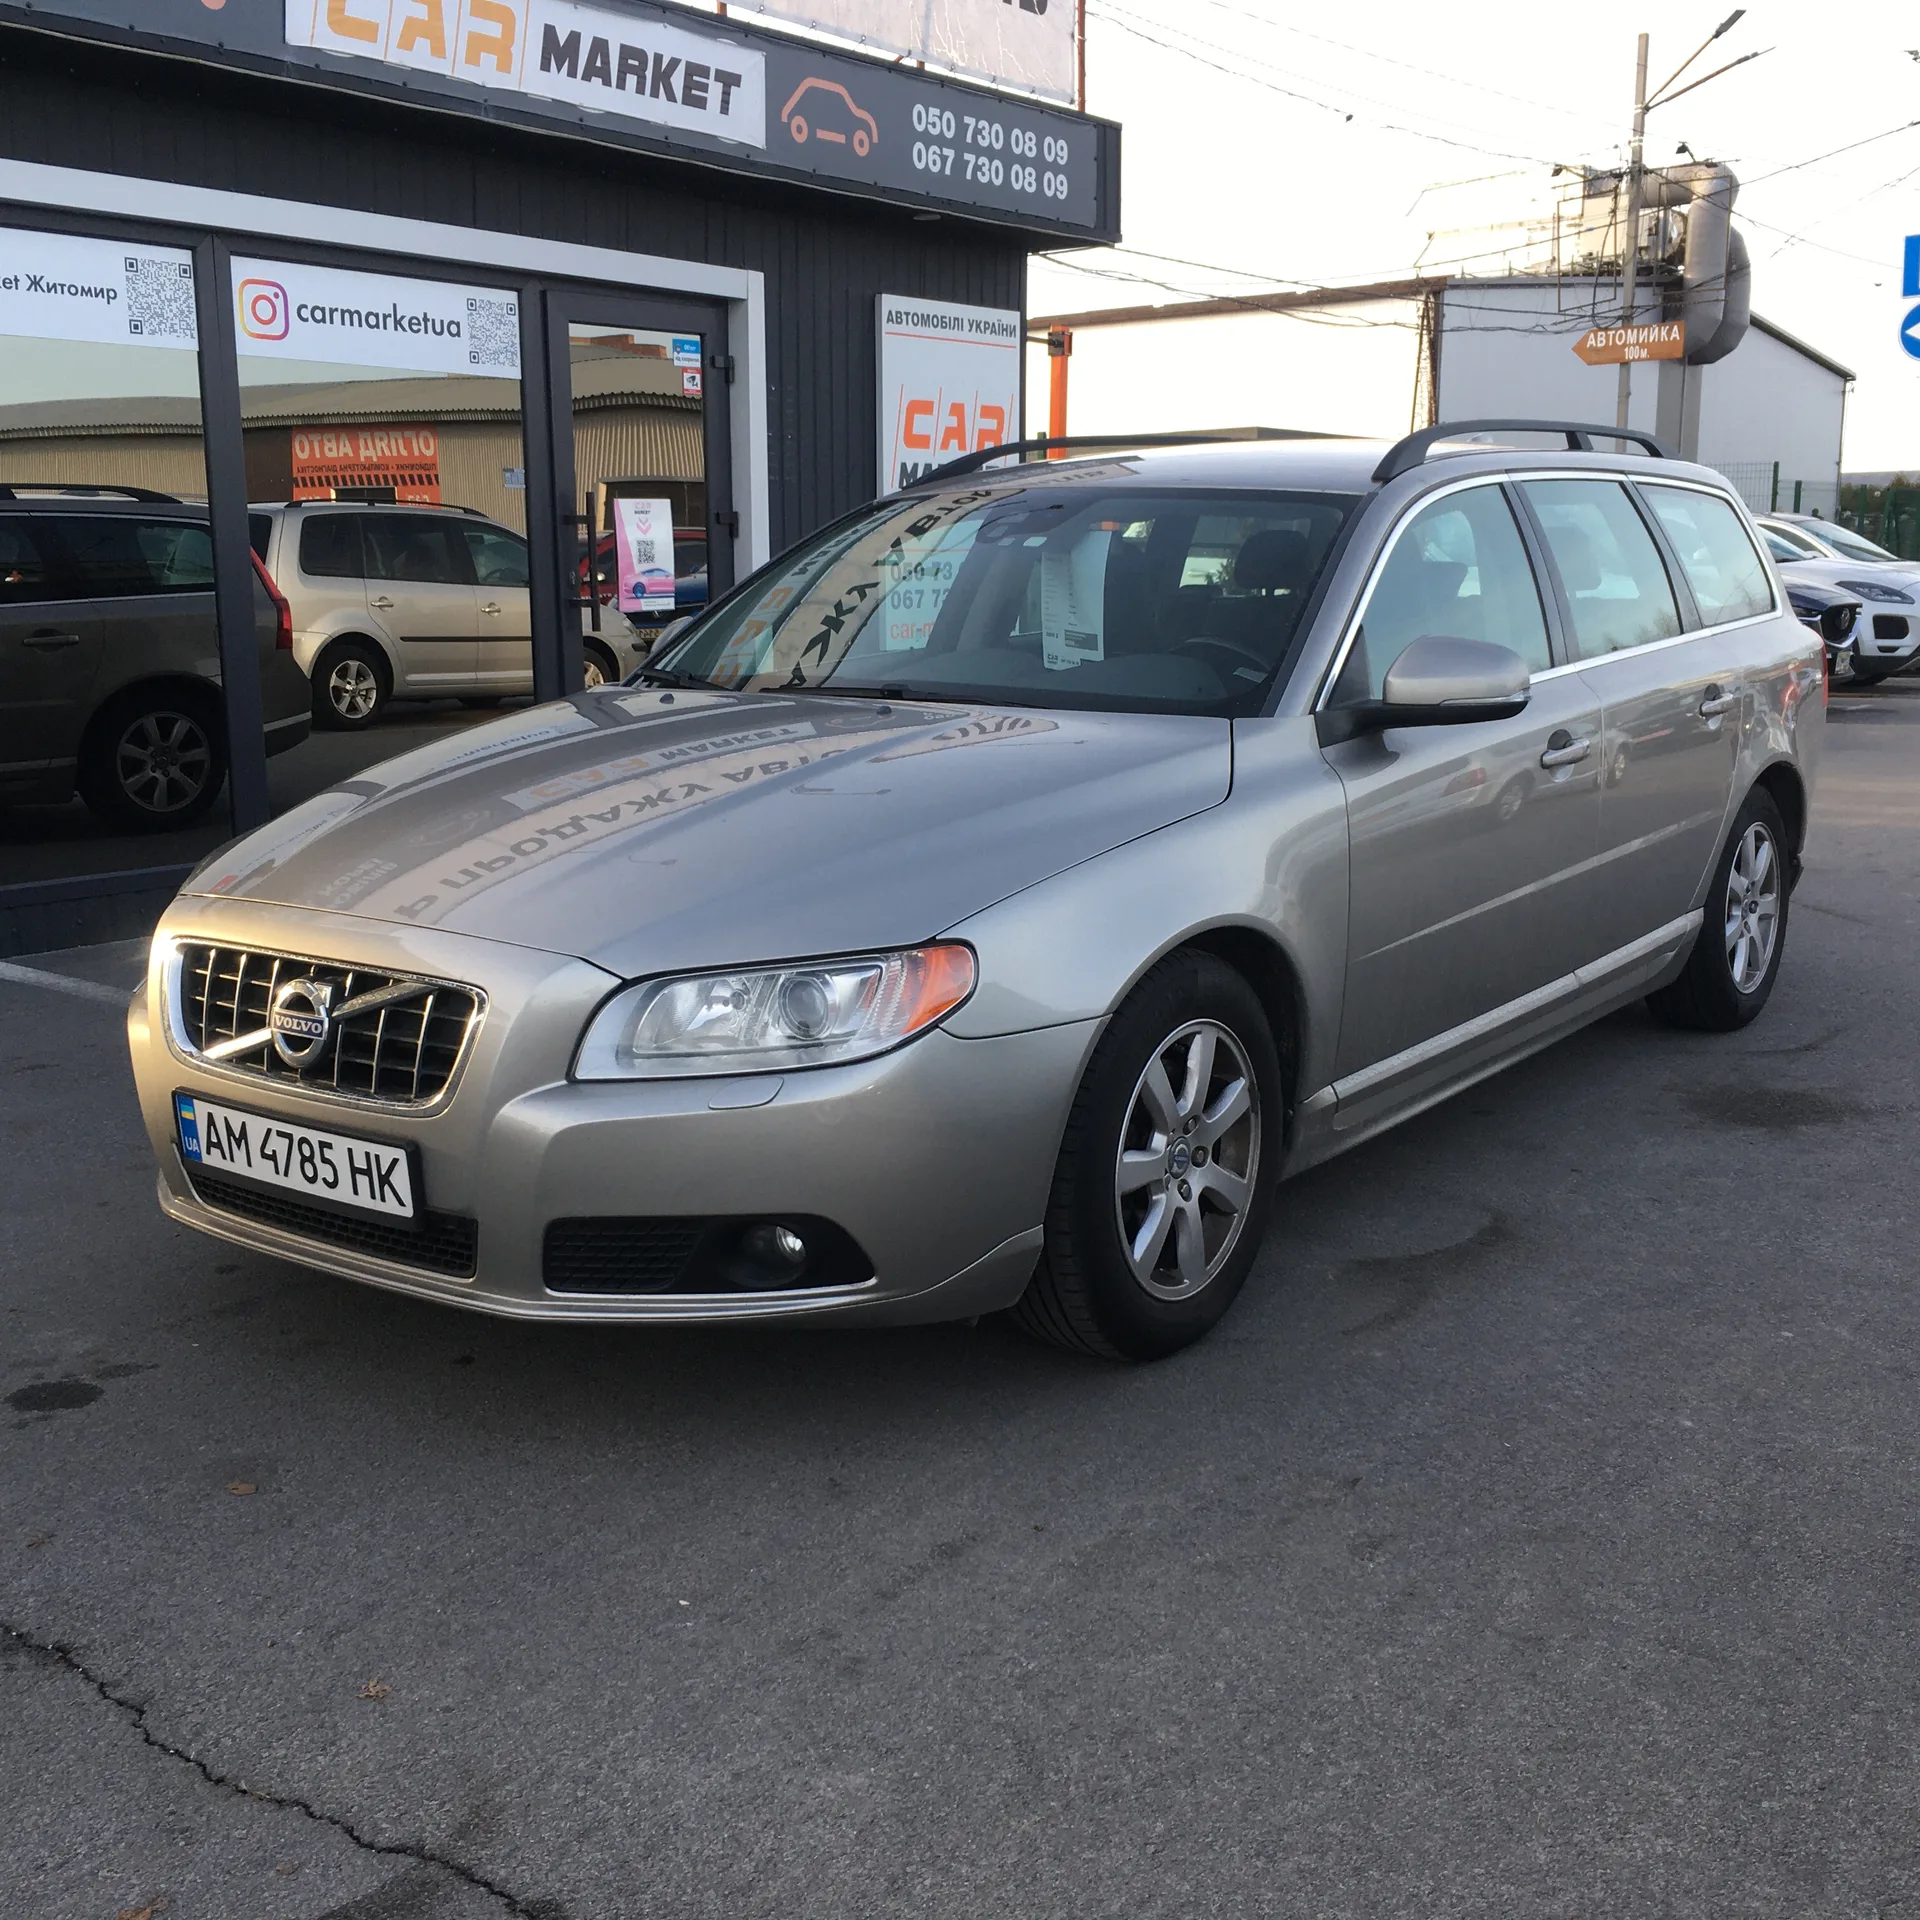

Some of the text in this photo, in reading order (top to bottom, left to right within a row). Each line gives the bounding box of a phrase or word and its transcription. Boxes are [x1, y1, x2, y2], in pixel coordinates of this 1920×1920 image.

[327, 0, 742, 115] CAR MARKET
[912, 103, 1068, 165] 050 730 08 09
[912, 141, 1068, 200] 067 730 08 09
[25, 274, 118, 304] Житомир
[296, 303, 461, 338] carmarketua
[886, 309, 1017, 338] АВТОМОБІЛІ УКРАЇНИ
[1586, 324, 1680, 348] АВТОМИЙКА
[903, 399, 1005, 451] CAR
[890, 589, 924, 610] 067
[274, 1014, 323, 1034] VOLVO
[185, 1136, 200, 1153] UA
[206, 1111, 407, 1207] AM 4785 HK
